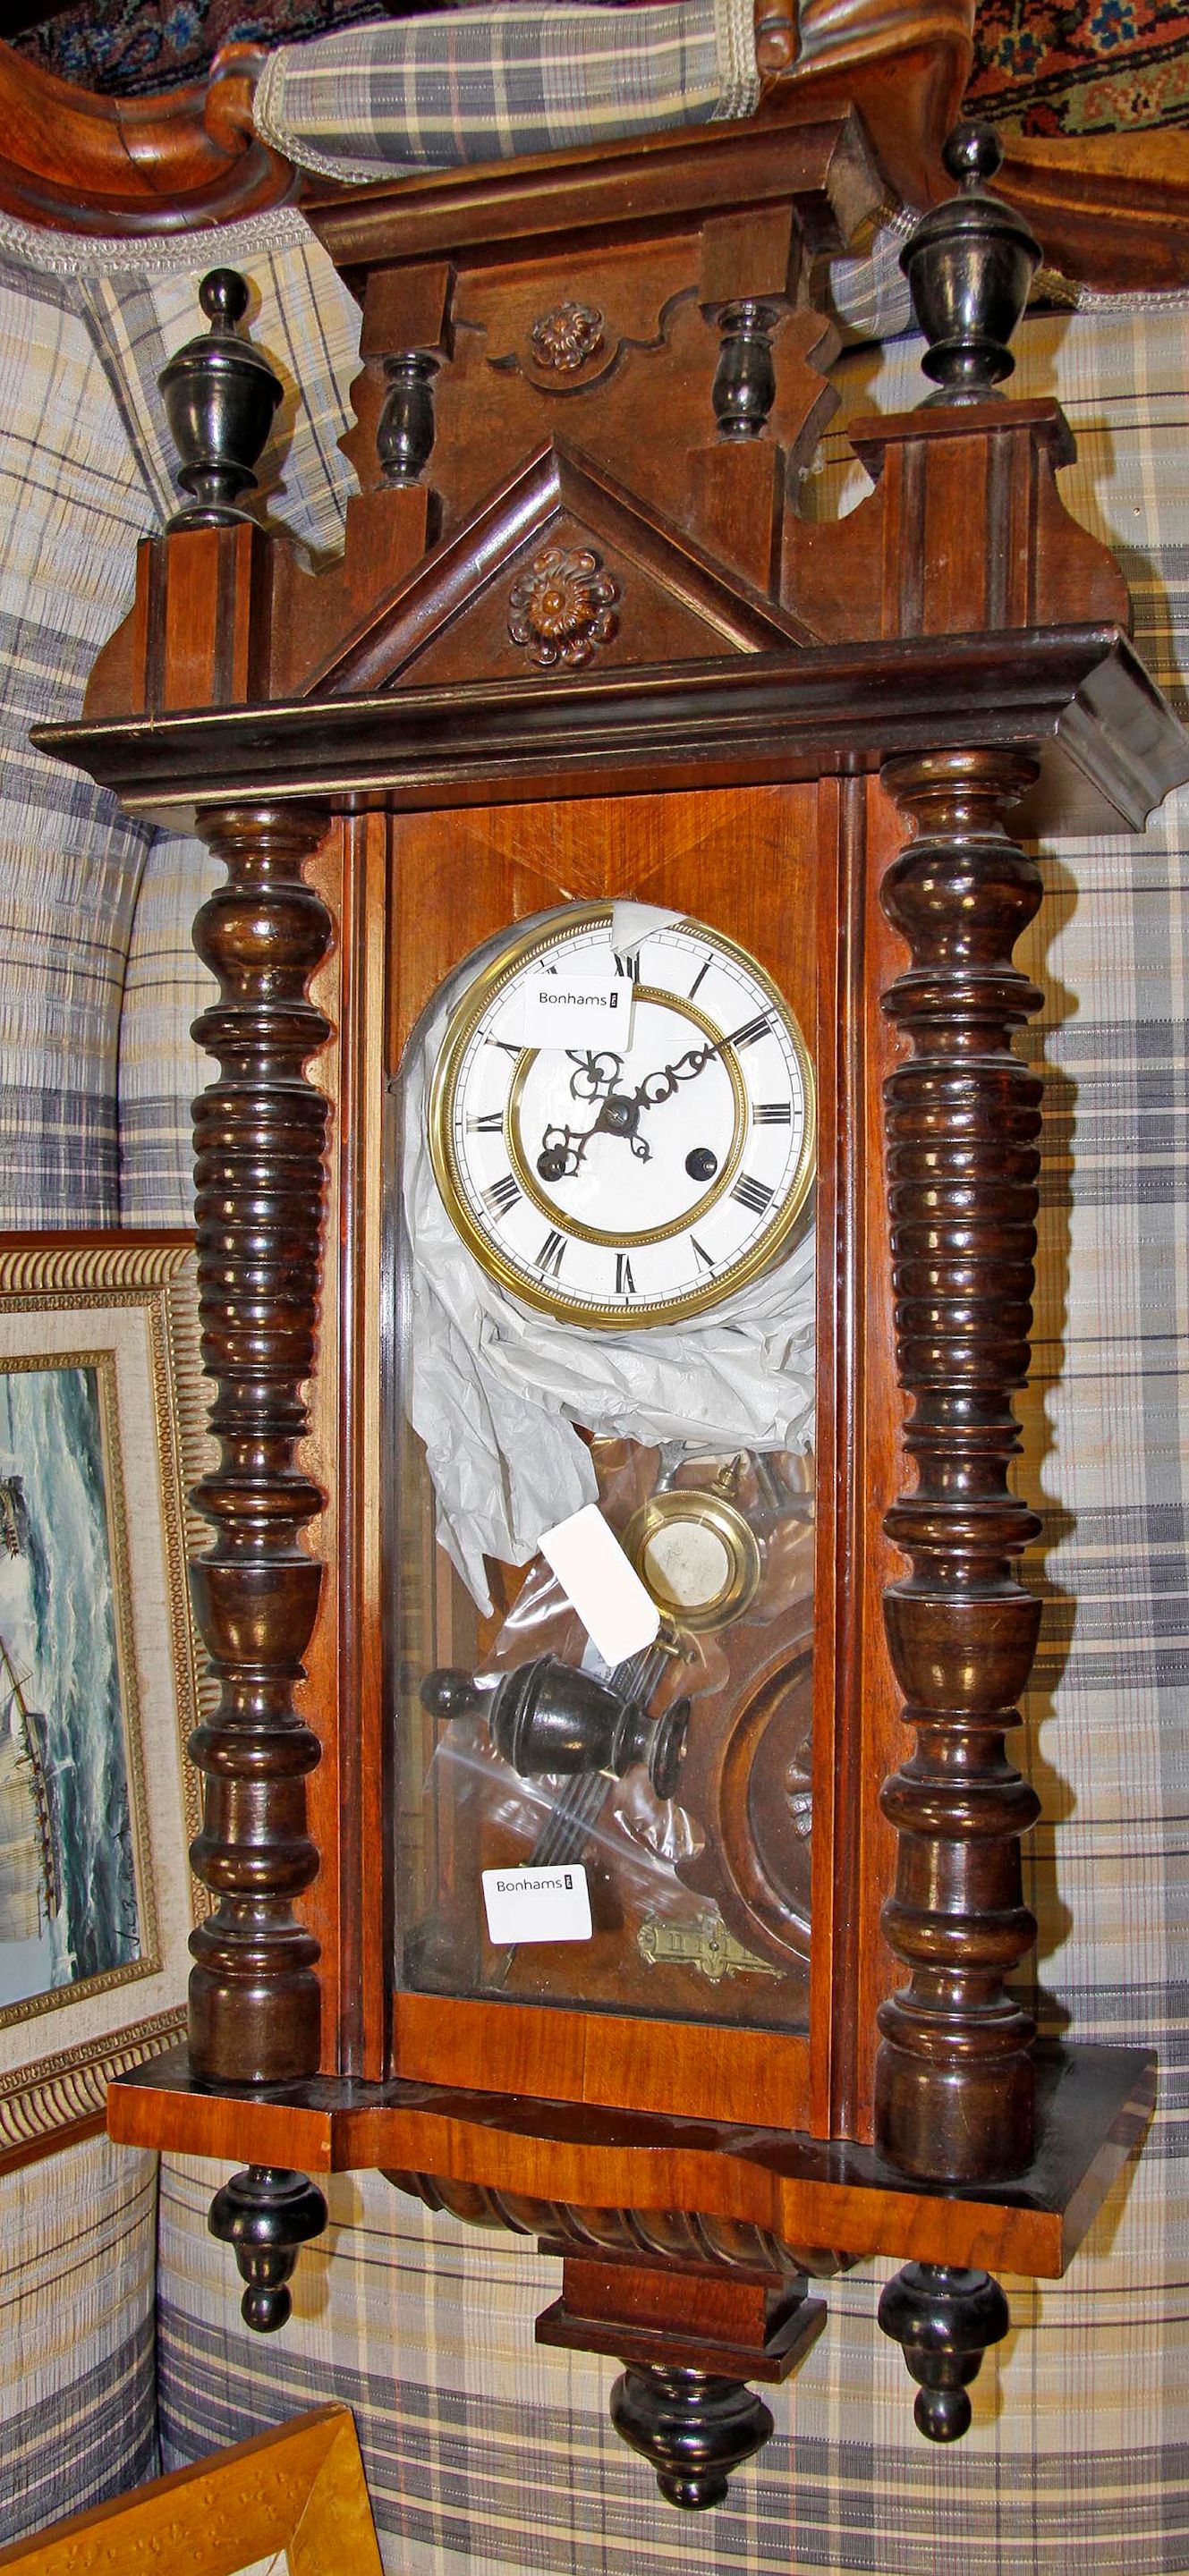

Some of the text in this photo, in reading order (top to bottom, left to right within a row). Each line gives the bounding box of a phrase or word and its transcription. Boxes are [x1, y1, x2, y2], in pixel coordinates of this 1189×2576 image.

[539, 992, 607, 1006] Bonhams
[689, 960, 711, 1001] I
[466, 1111, 504, 1134] IX
[753, 1102, 791, 1125] III
[480, 1174, 522, 1222] VIII
[729, 1173, 776, 1216] IIII
[535, 1230, 567, 1277] VII
[616, 1253, 638, 1293] VI
[691, 1234, 716, 1273] V
[497, 1879, 563, 1892] Bonhams
